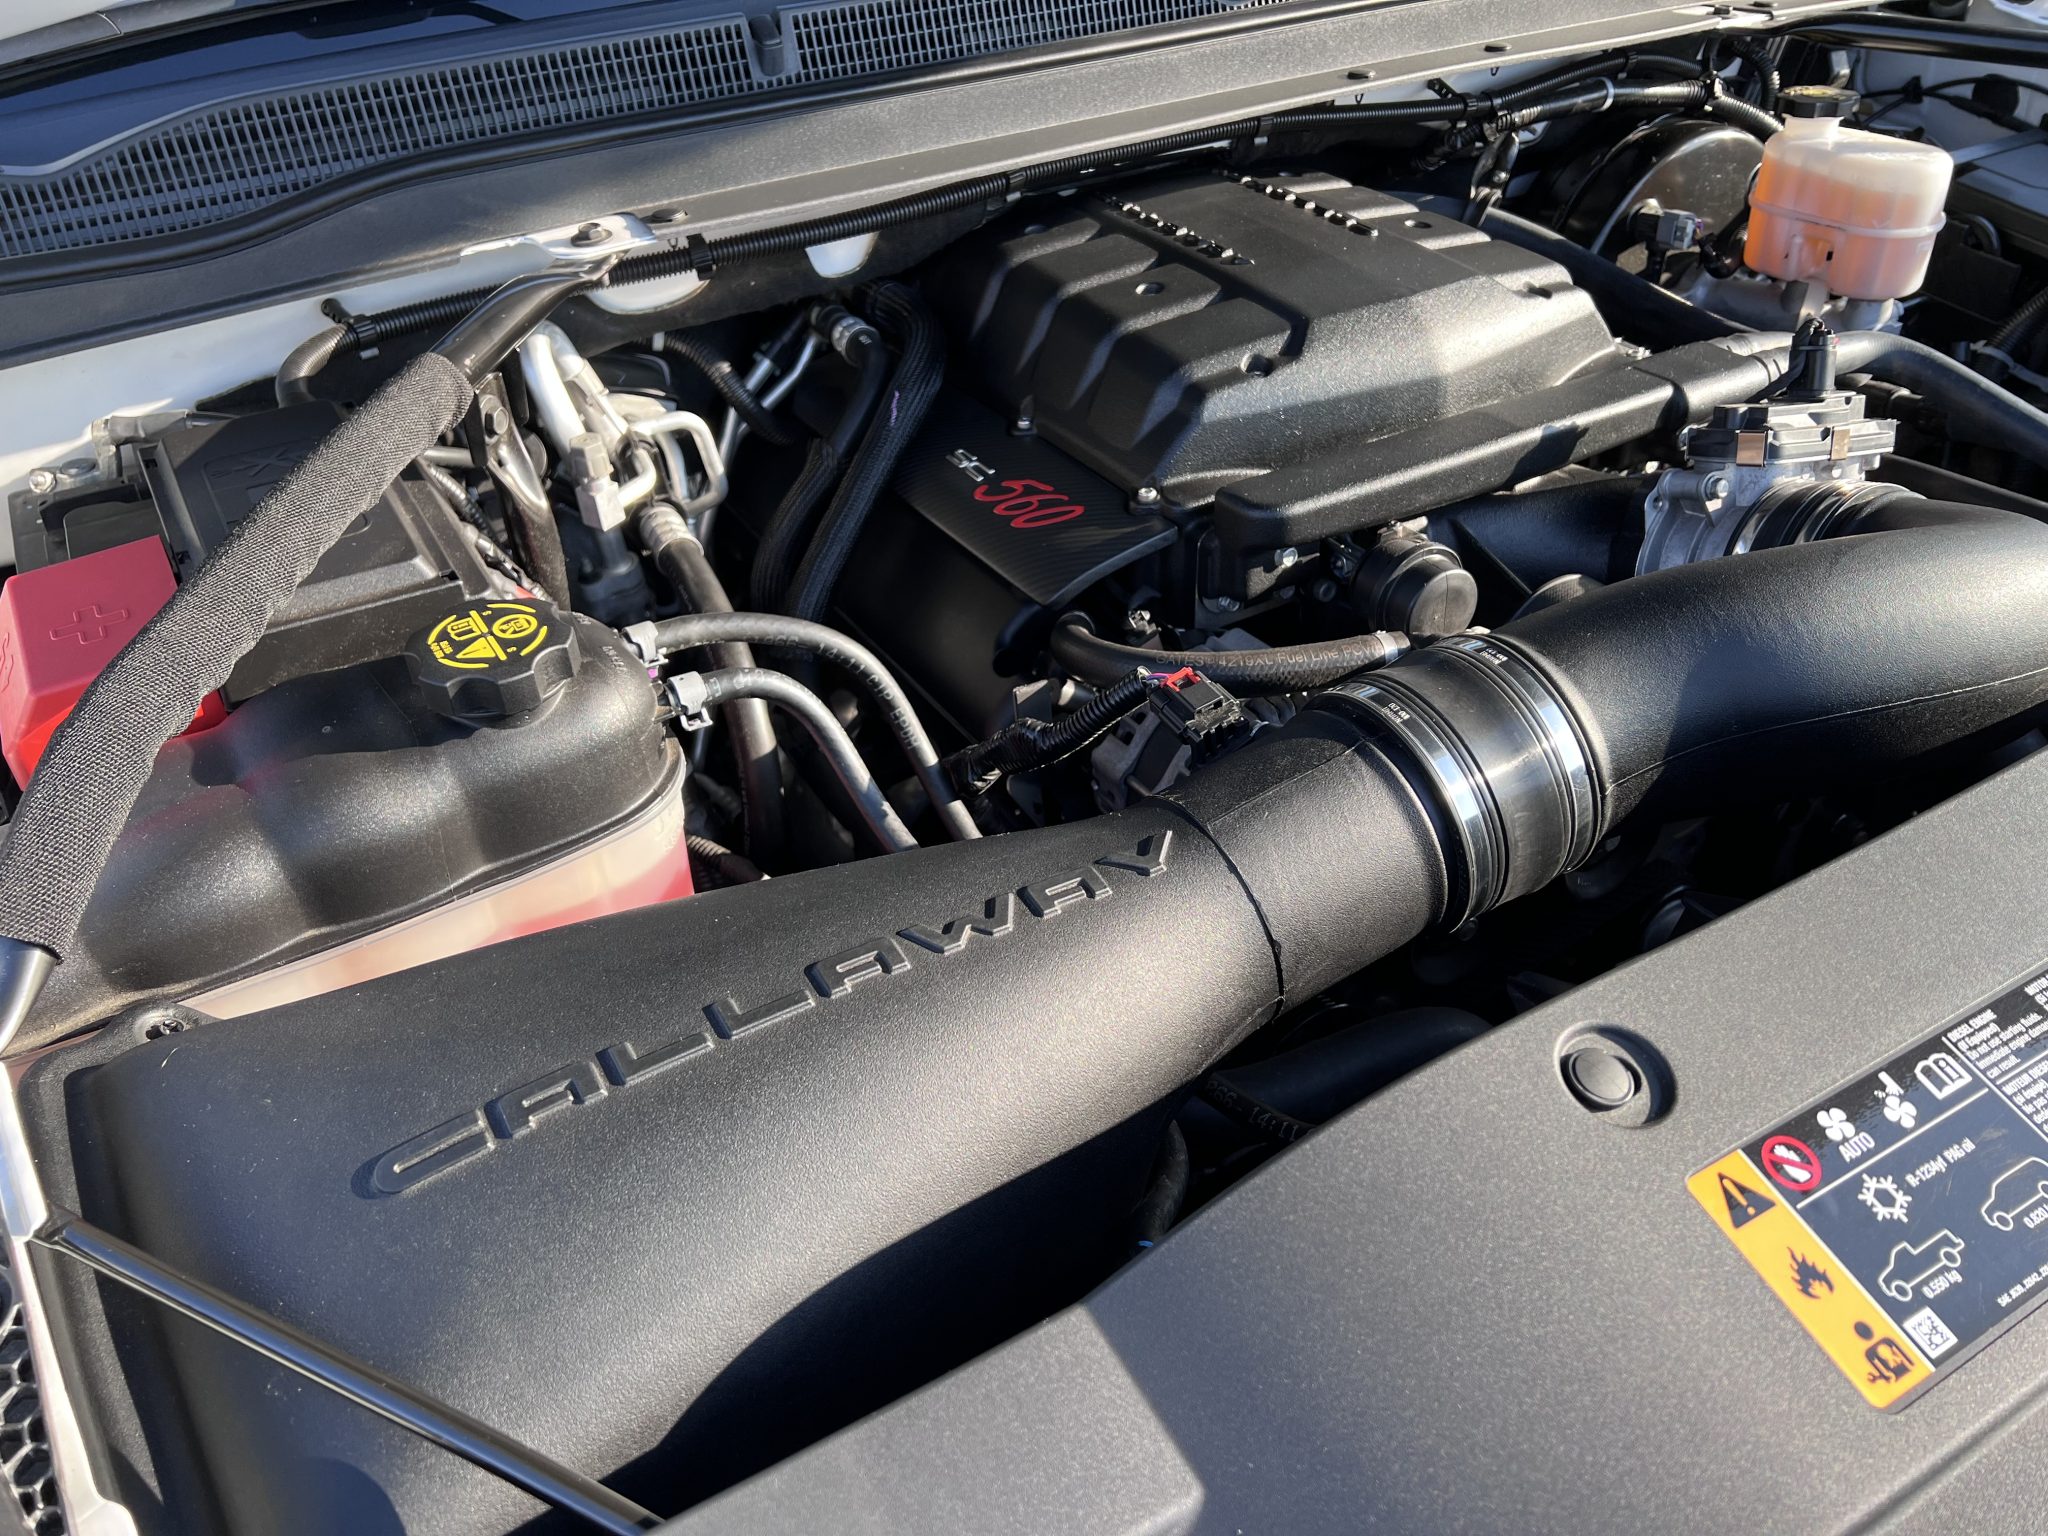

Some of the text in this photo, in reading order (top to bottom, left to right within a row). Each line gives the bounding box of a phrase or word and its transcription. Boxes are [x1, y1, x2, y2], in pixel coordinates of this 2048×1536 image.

[946, 449, 1085, 529] SC 560
[1277, 651, 1307, 664] Fuel
[1312, 647, 1339, 661] Line
[354, 829, 1174, 1197] CALLAWAY
[1947, 1009, 1997, 1043] DIESEL ENGINE
[1965, 1022, 2001, 1047] Equipped)
[1977, 1042, 1990, 1055] not
[1999, 1023, 2026, 1041] starting
[1975, 1045, 2011, 1070] Immediate
[1986, 1066, 2001, 1079] can
[2002, 1072, 2033, 1096] MOTEUR
[1838, 1131, 1875, 1162] AUTO
[1905, 1136, 1976, 1187] R-1234yf PAG oil
[2023, 1206, 2048, 1228] 0.820
[1921, 1269, 1963, 1299] 0.550 kg
